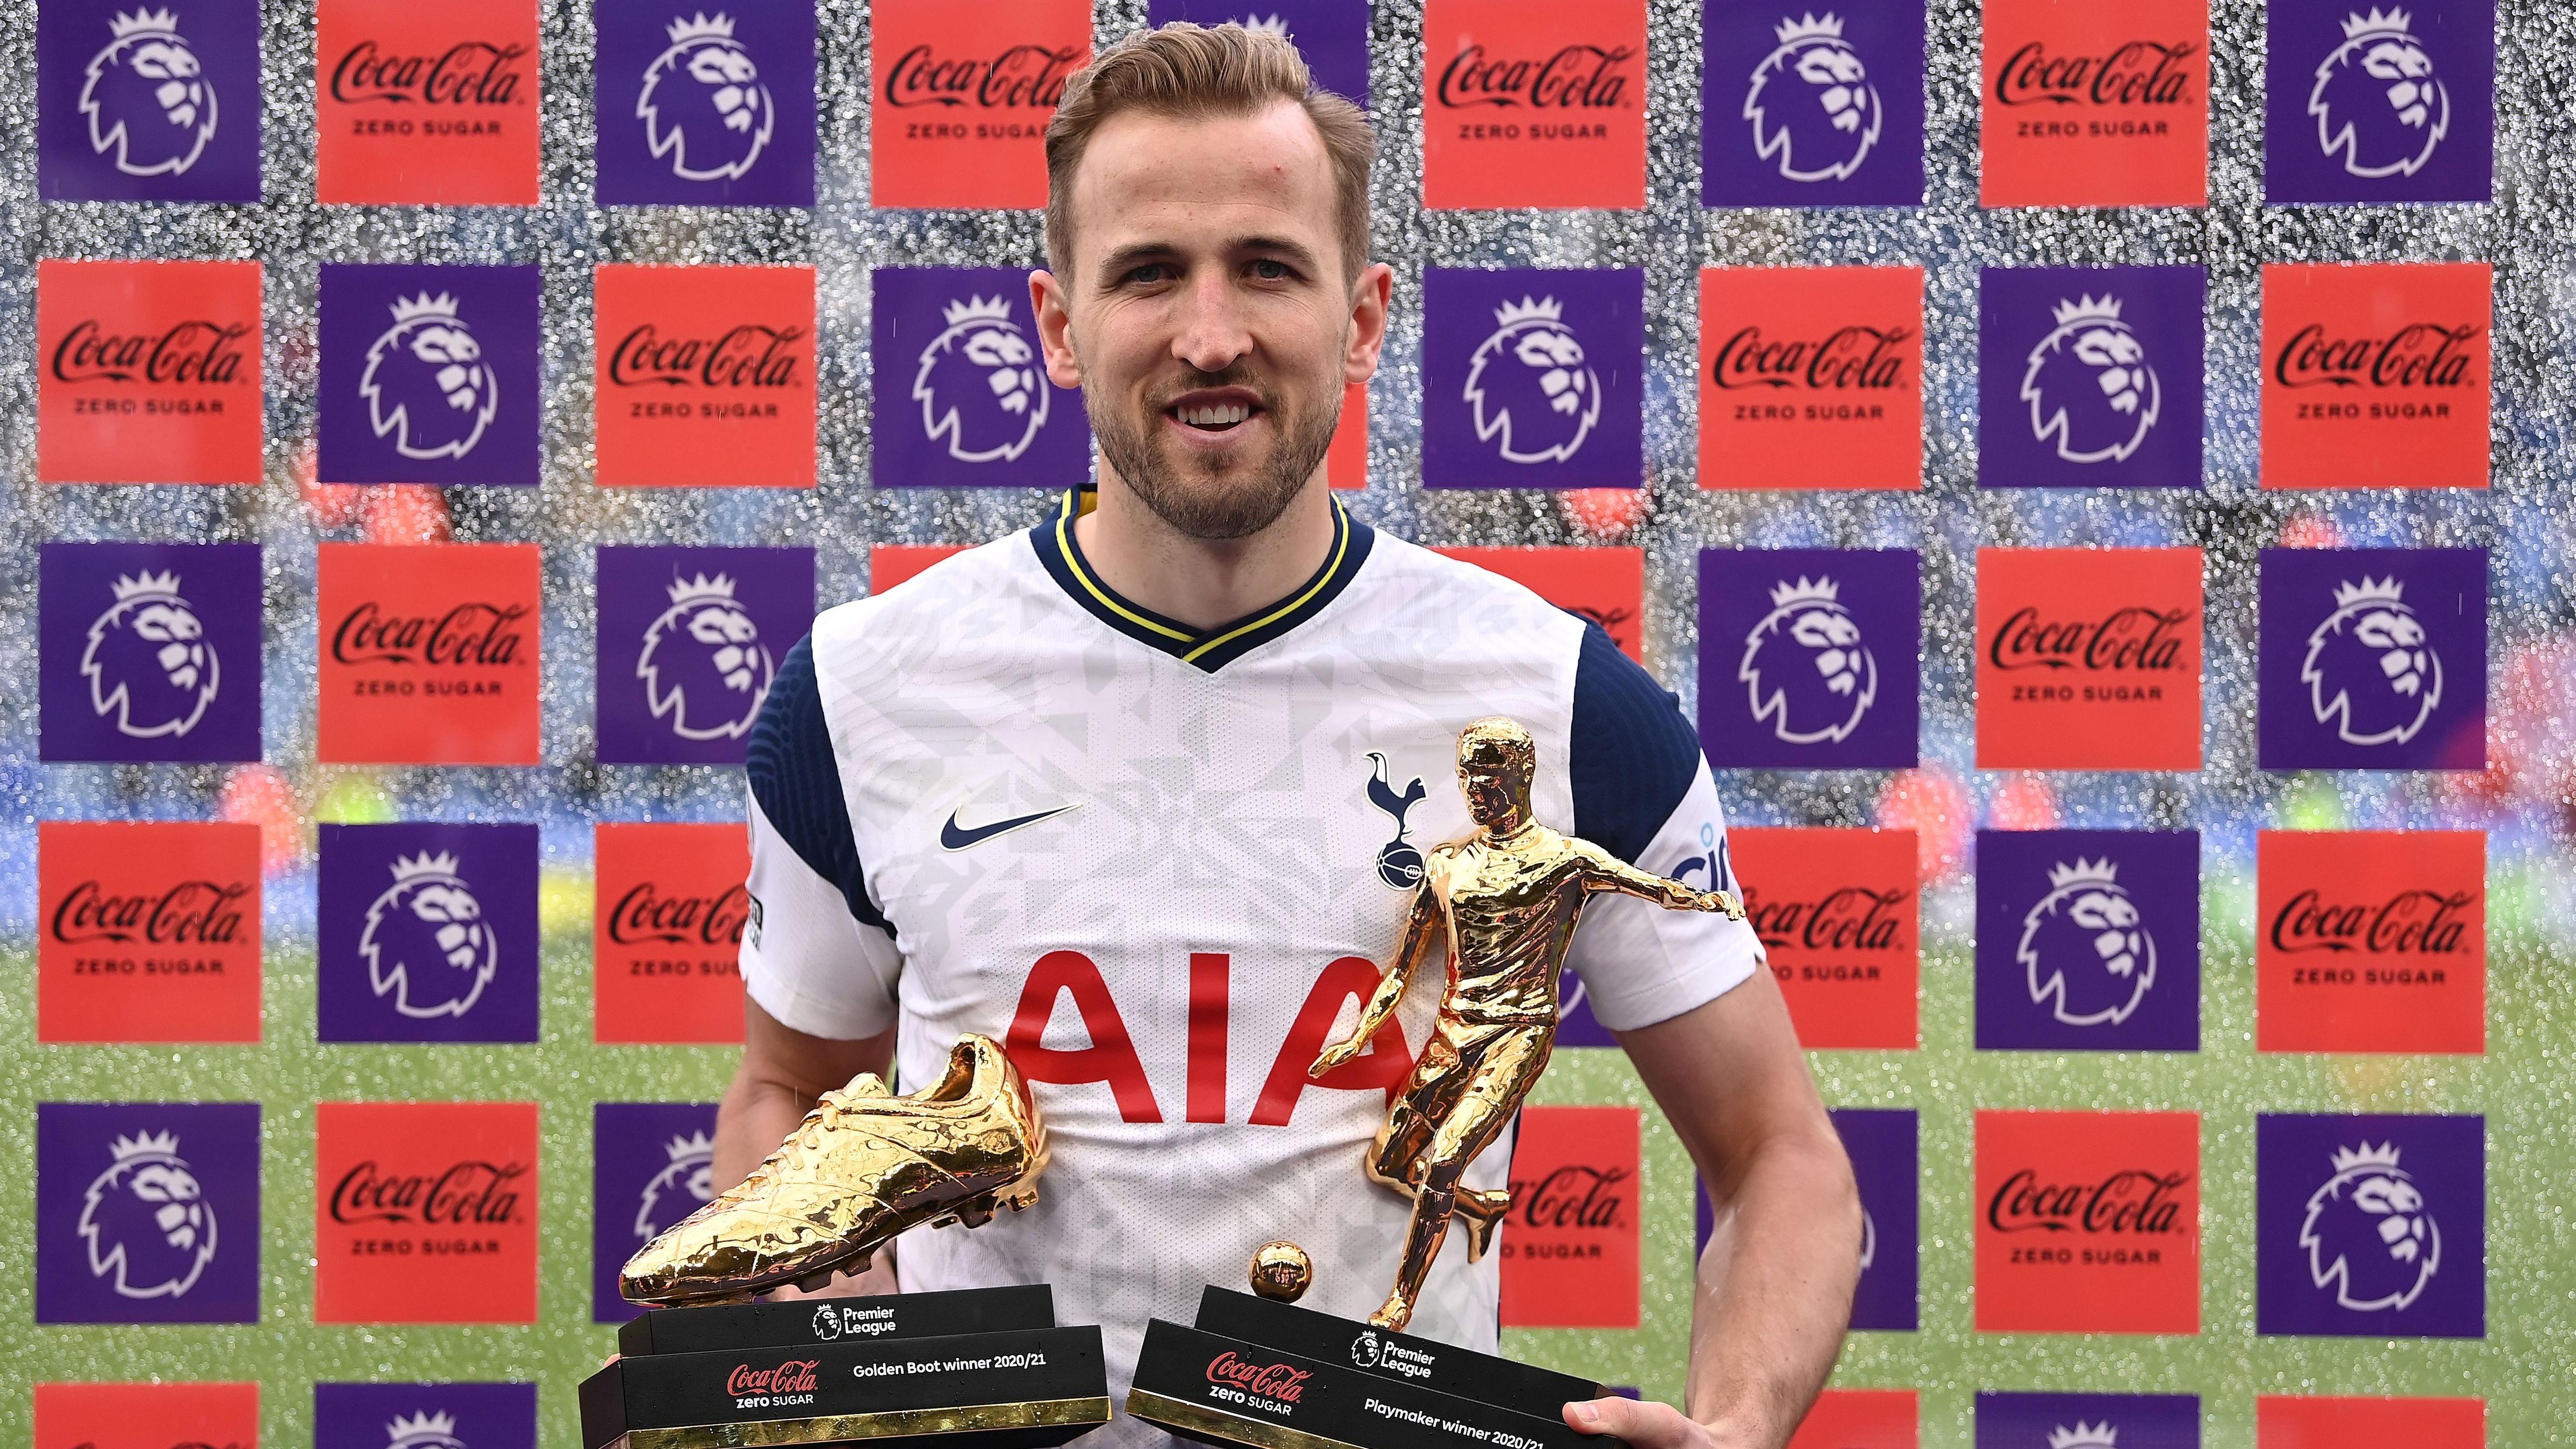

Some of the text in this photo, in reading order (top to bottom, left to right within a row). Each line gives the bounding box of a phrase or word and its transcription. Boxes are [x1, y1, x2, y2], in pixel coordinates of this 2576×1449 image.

[329, 41, 527, 105] Coca-Cola
[1437, 45, 1638, 109] Coca-Cola
[1995, 41, 2196, 106] Coca-Cola
[353, 121, 501, 135] ZERO SUGAR
[906, 124, 968, 138] ZERO
[1459, 125, 1606, 139] ZERO SUGAR
[2018, 121, 2168, 136] ZERO SUGAR
[51, 320, 249, 384] Coca-Cola
[608, 324, 804, 388] Coca-Cola
[1712, 326, 1911, 390] Coca-Cola
[2274, 323, 2478, 388] Coca-Cola
[75, 399, 224, 413] ZERO SUGAR
[631, 404, 777, 418] ZERO SUGAR
[1735, 406, 1883, 419] ZERO SUGAR
[2298, 403, 2450, 419] ZERO SUGAR
[331, 602, 527, 666] Coca-Cola
[1989, 607, 2190, 671] Coca-Cola
[355, 682, 502, 695] ZERO SUGAR
[2013, 687, 2162, 701] ZERO SUGAR
[51, 881, 249, 944] Coca-Cola
[2270, 889, 2473, 954] Coca-Cola
[75, 960, 223, 974] ZERO SUGAR
[631, 961, 690, 975] ZERO
[1802, 965, 1880, 980] SUGAR
[2294, 969, 2445, 984] ZERO SUGAR
[1005, 950, 1415, 1126] AIA
[329, 1161, 526, 1225] Coca-Cola
[1987, 1169, 2188, 1235] Coca-Cola
[352, 1240, 499, 1255] ZERO SUGAR
[1524, 1244, 1602, 1259] SUGAR
[2010, 1249, 2161, 1265] ZERO SUGAR
[843, 1306, 895, 1320] Premier
[844, 1320, 896, 1336] League
[1384, 1340, 1436, 1365] Premier
[727, 1359, 821, 1396] Coca-Cola
[853, 1353, 1047, 1378] Golden Boot winner 2020/21
[1206, 1351, 1314, 1404] Coca-Cola
[1380, 1354, 1432, 1378] League
[736, 1394, 814, 1409] zero SUGAR
[1209, 1385, 1292, 1416] zero SUGAR
[1364, 1398, 1440, 1428] Playmaker
[1442, 1419, 1491, 1441] winner
